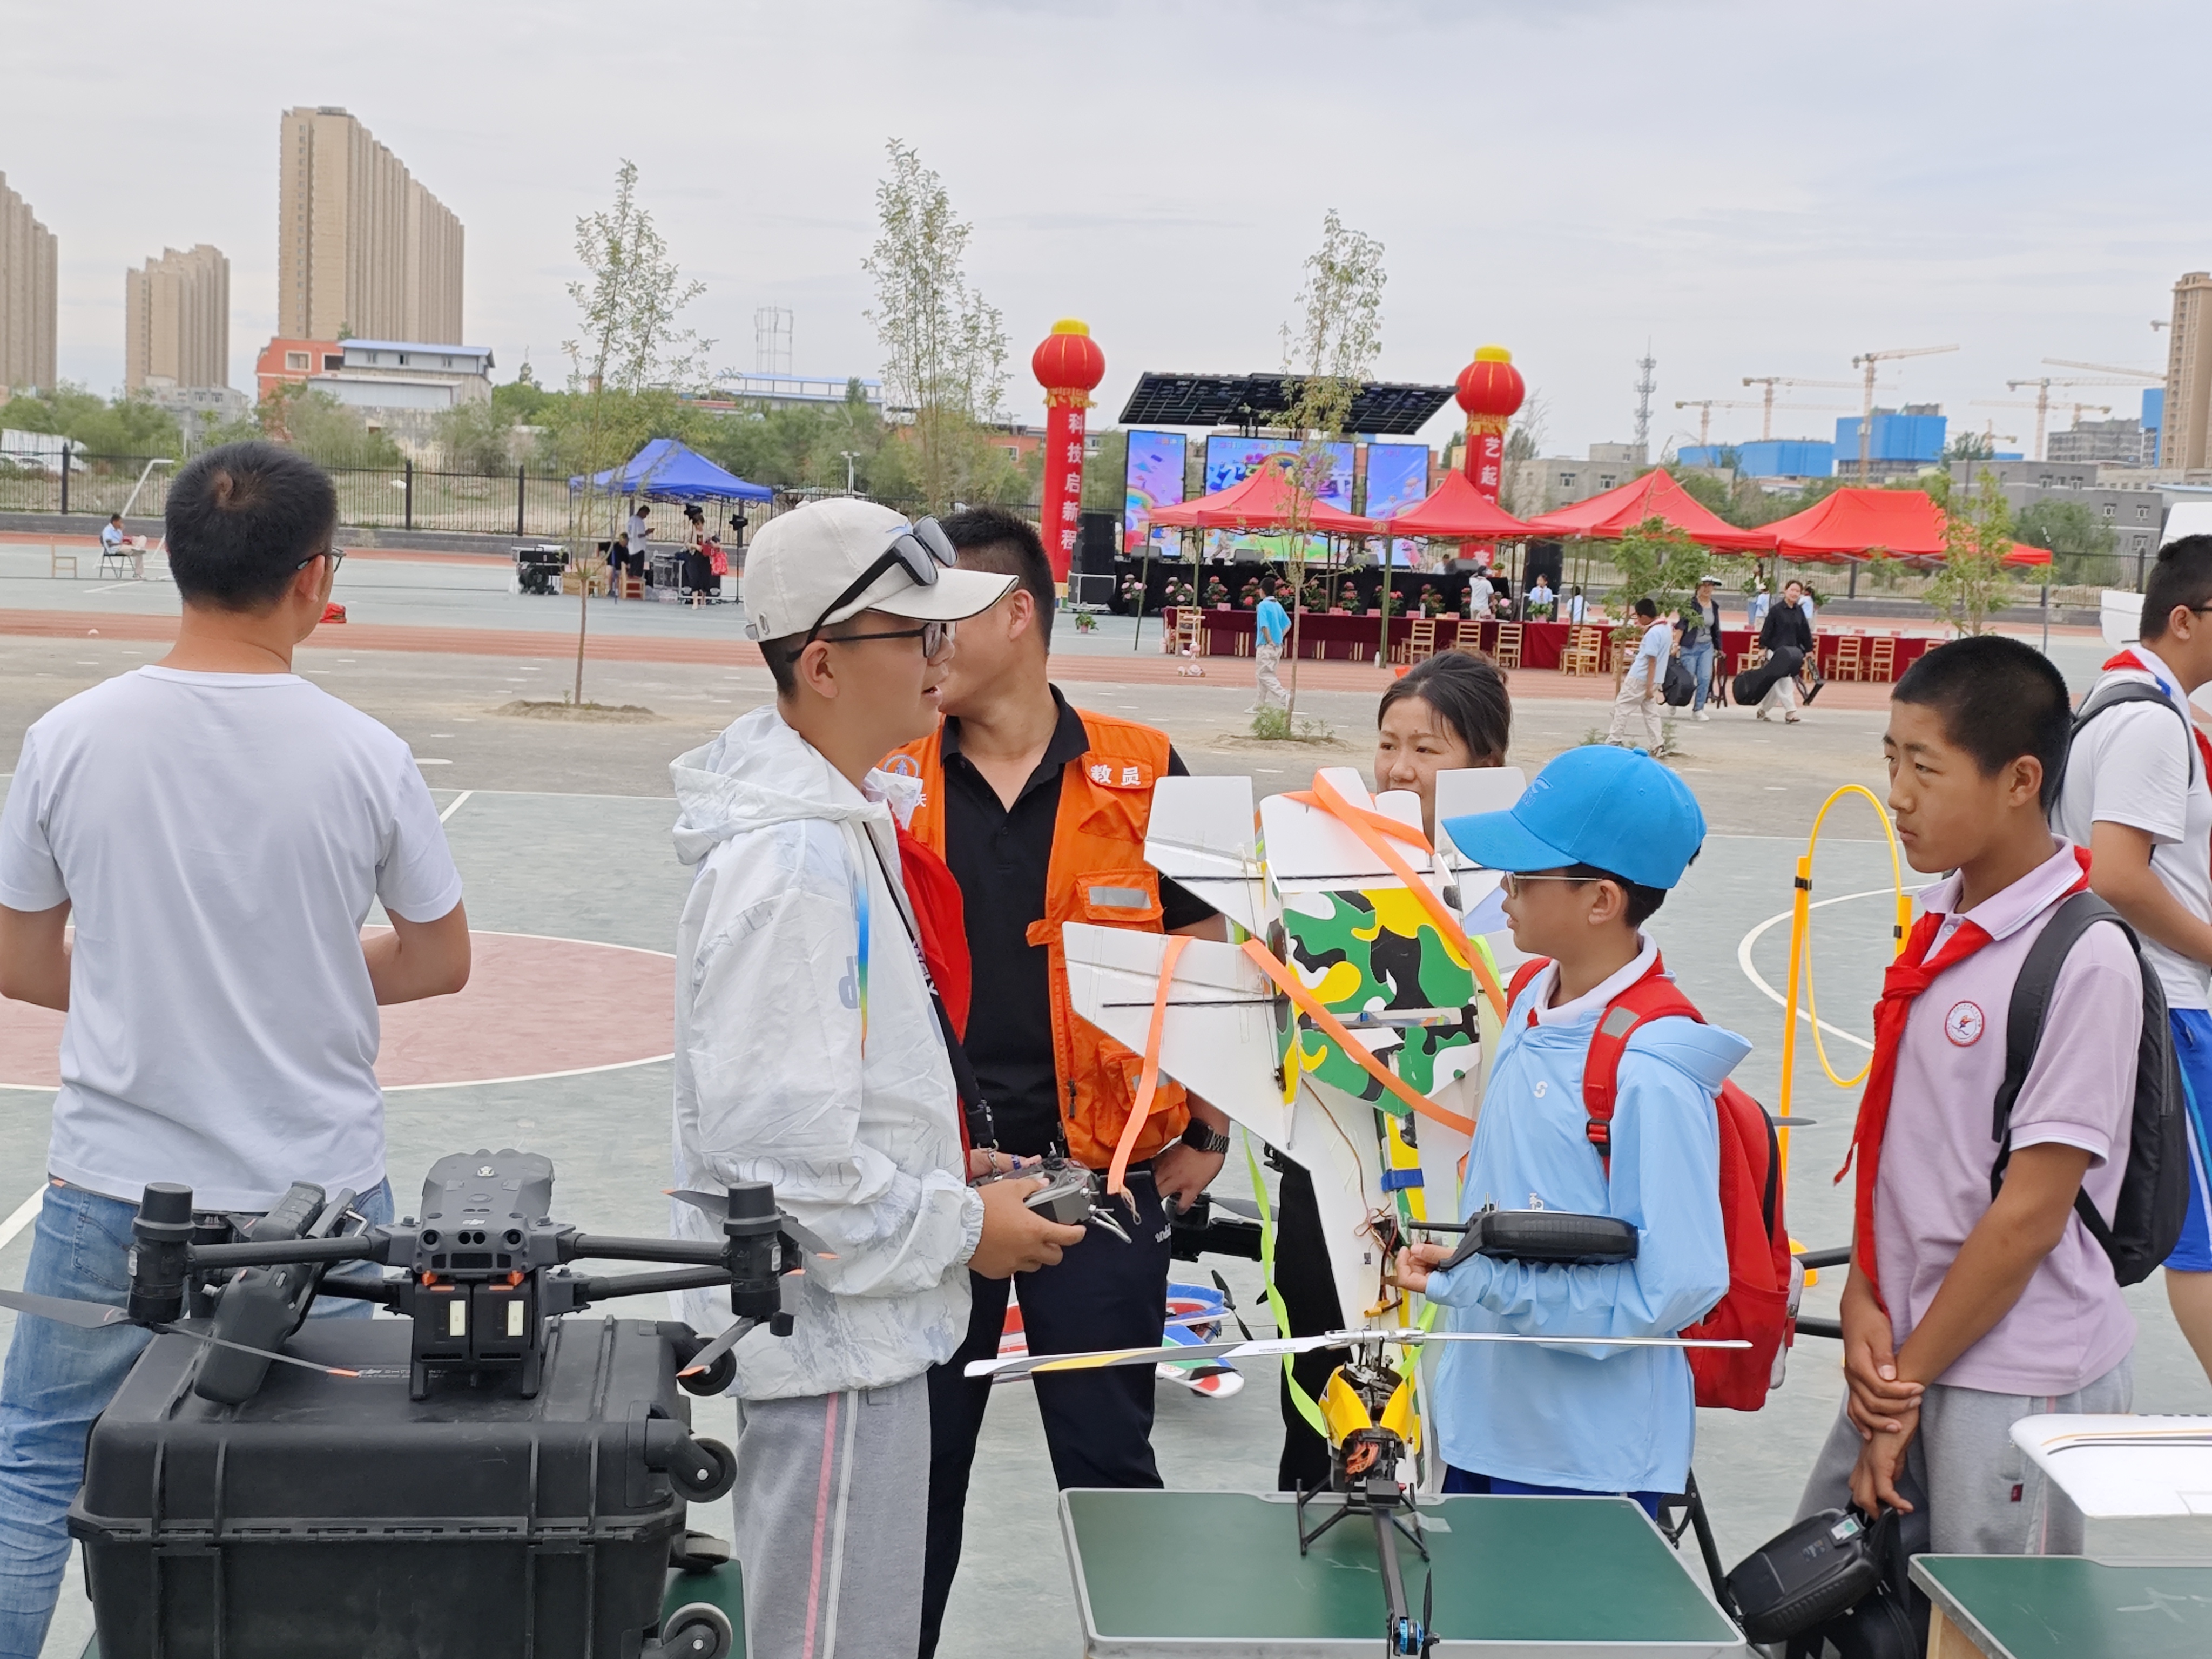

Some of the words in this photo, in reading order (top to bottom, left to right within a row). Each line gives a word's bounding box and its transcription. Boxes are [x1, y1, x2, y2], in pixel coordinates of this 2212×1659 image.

[1061, 413, 1083, 550] 科技启新程
[1091, 764, 1141, 786] 教员
